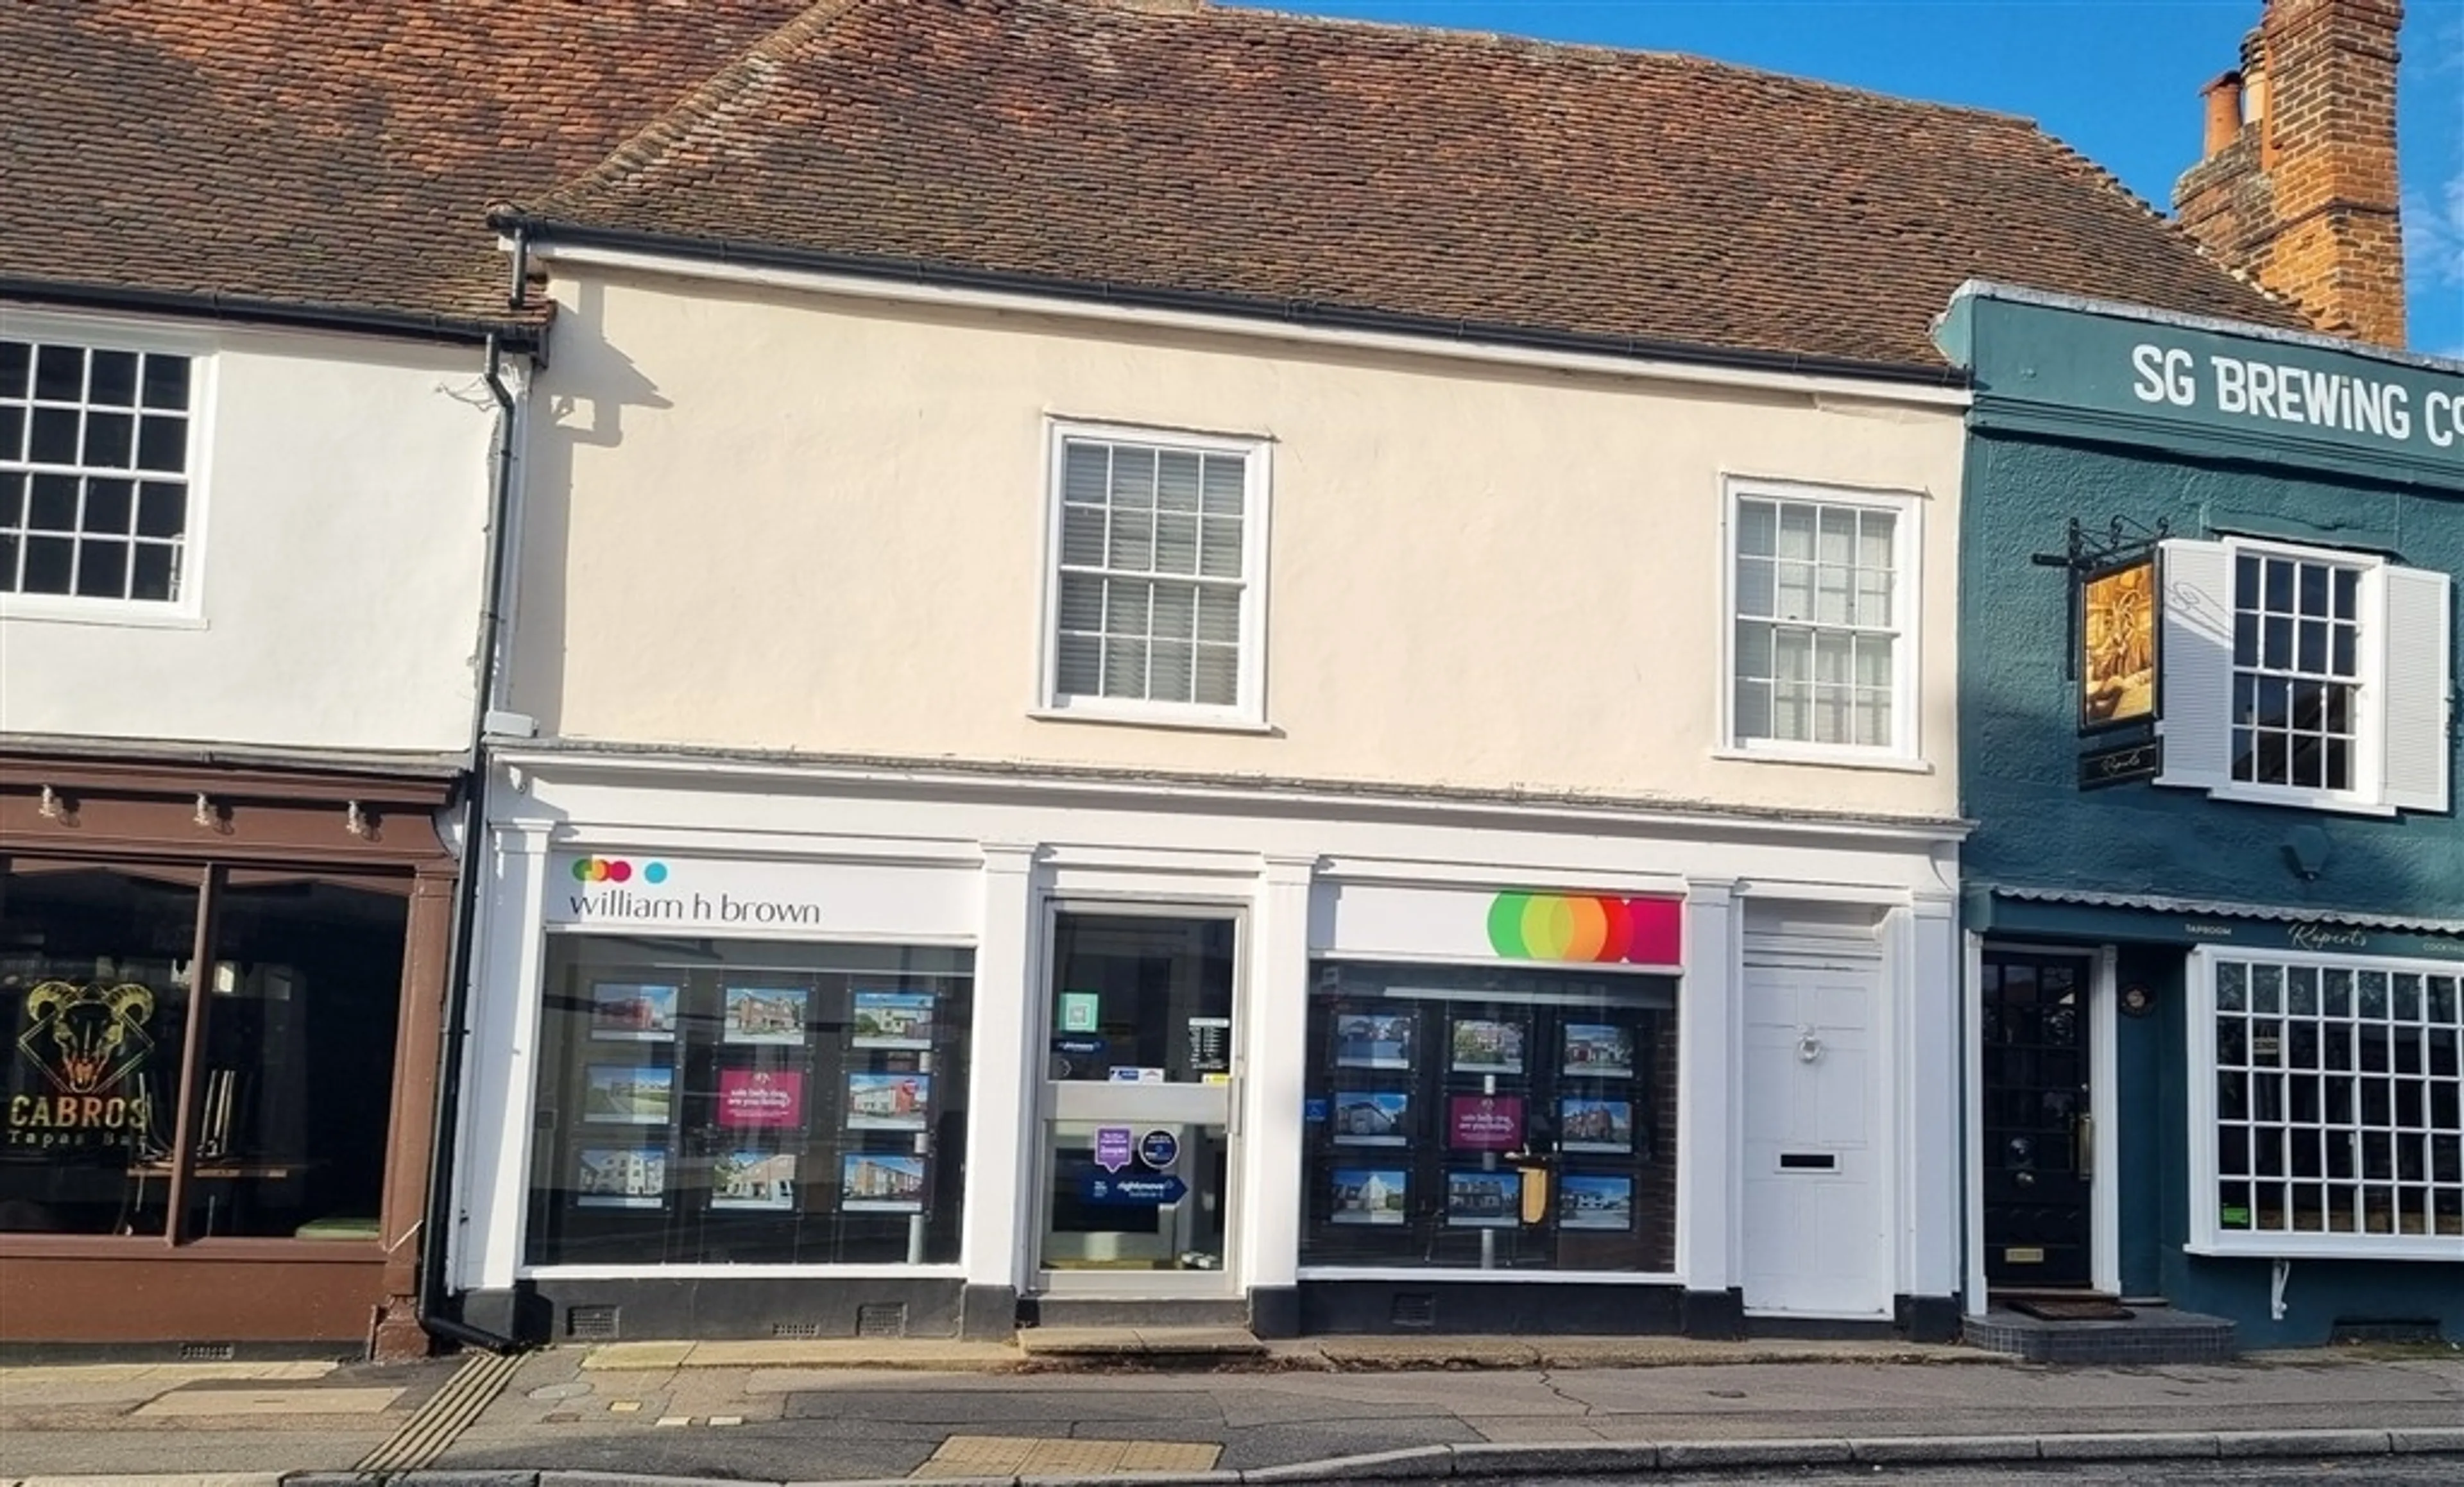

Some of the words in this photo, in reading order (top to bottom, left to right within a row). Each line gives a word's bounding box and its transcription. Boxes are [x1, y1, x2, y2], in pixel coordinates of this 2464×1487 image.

[2132, 344, 2196, 407] SG
[570, 889, 683, 919] william
[693, 892, 711, 920] h
[721, 894, 821, 924] brown
[9, 1094, 145, 1127] CABROS
[8, 1130, 85, 1148] Tapas
